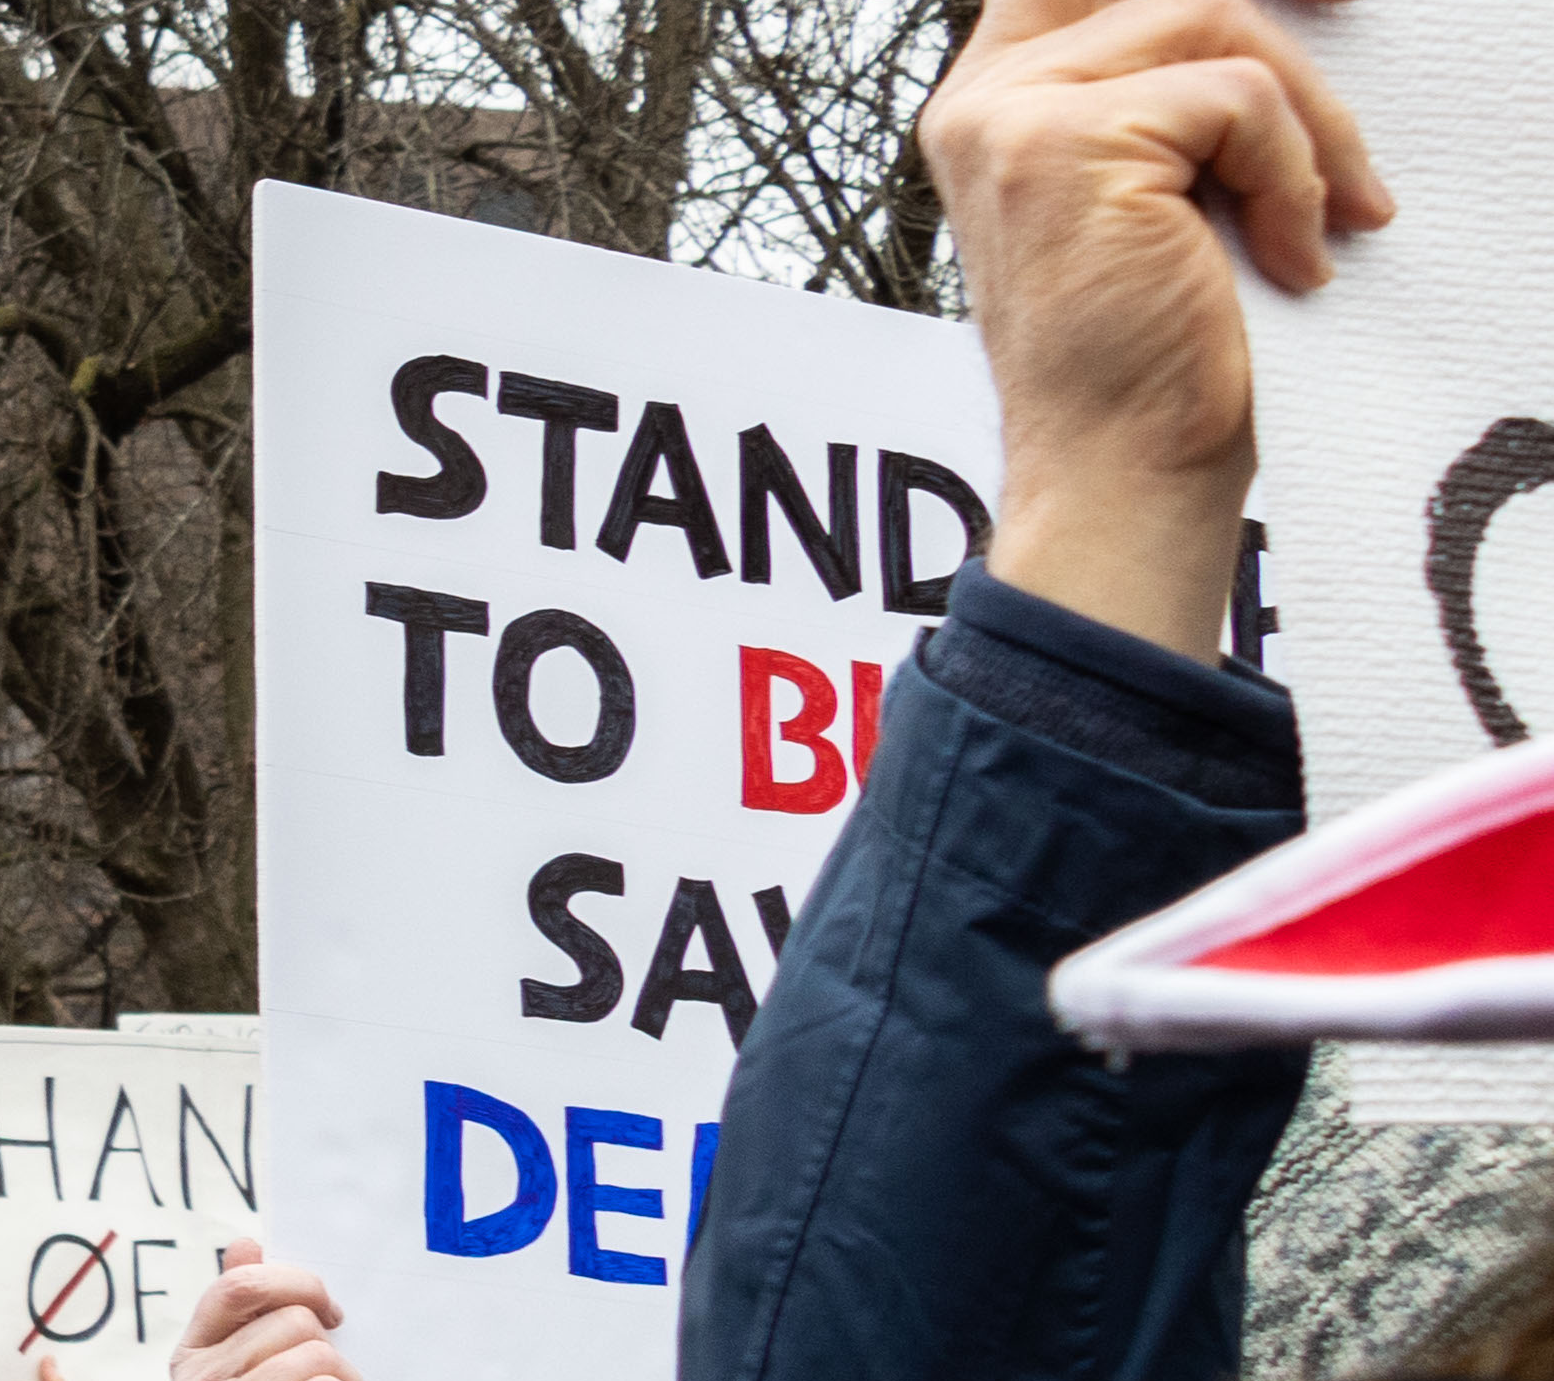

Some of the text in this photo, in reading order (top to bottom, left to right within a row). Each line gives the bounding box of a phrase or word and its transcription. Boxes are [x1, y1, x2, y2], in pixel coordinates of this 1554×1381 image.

[376, 353, 996, 615] STAND
[365, 581, 636, 785] TO
[423, 1080, 723, 1287] DE
